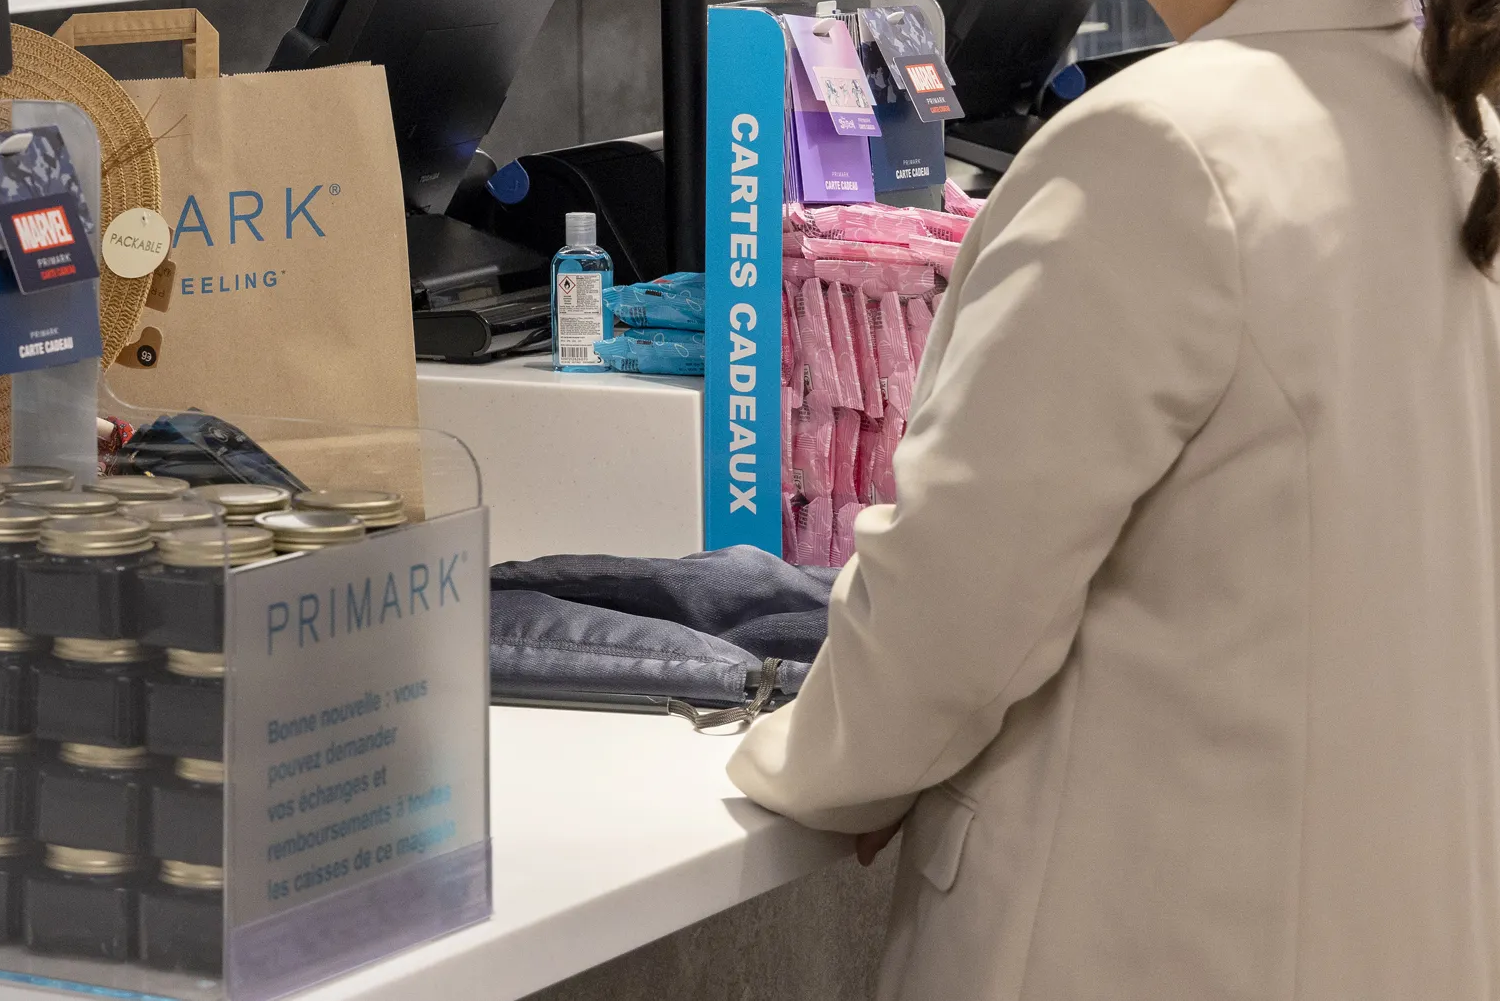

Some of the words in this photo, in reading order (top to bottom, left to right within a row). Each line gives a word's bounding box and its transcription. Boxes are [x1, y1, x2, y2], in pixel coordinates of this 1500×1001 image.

[907, 65, 944, 91] MARVEL
[825, 181, 840, 190] CARTE
[840, 181, 858, 191] CADEAU
[895, 169, 912, 179] CARTE
[912, 166, 930, 178] CADEAU
[730, 113, 759, 288] CARTES
[13, 209, 73, 251] MARVEL
[109, 233, 163, 254] PACKABLE
[37, 253, 73, 269] PRIMARK
[181, 270, 278, 295] EELING
[19, 342, 45, 359] CARTE
[45, 336, 74, 354] CADEAU
[729, 303, 757, 515] CADEAUX
[266, 553, 460, 656] PRIMARK
[267, 708, 318, 745] Bonne
[320, 687, 381, 729] nouvelle
[393, 679, 429, 705] vous
[267, 752, 321, 790] pouvez
[324, 724, 398, 765] demander
[267, 798, 295, 823] vos
[373, 765, 388, 789] et
[267, 802, 391, 863] remboursements
[267, 875, 289, 901] les
[293, 859, 349, 894] caisses
[353, 847, 371, 873] de
[375, 842, 393, 865] ce
